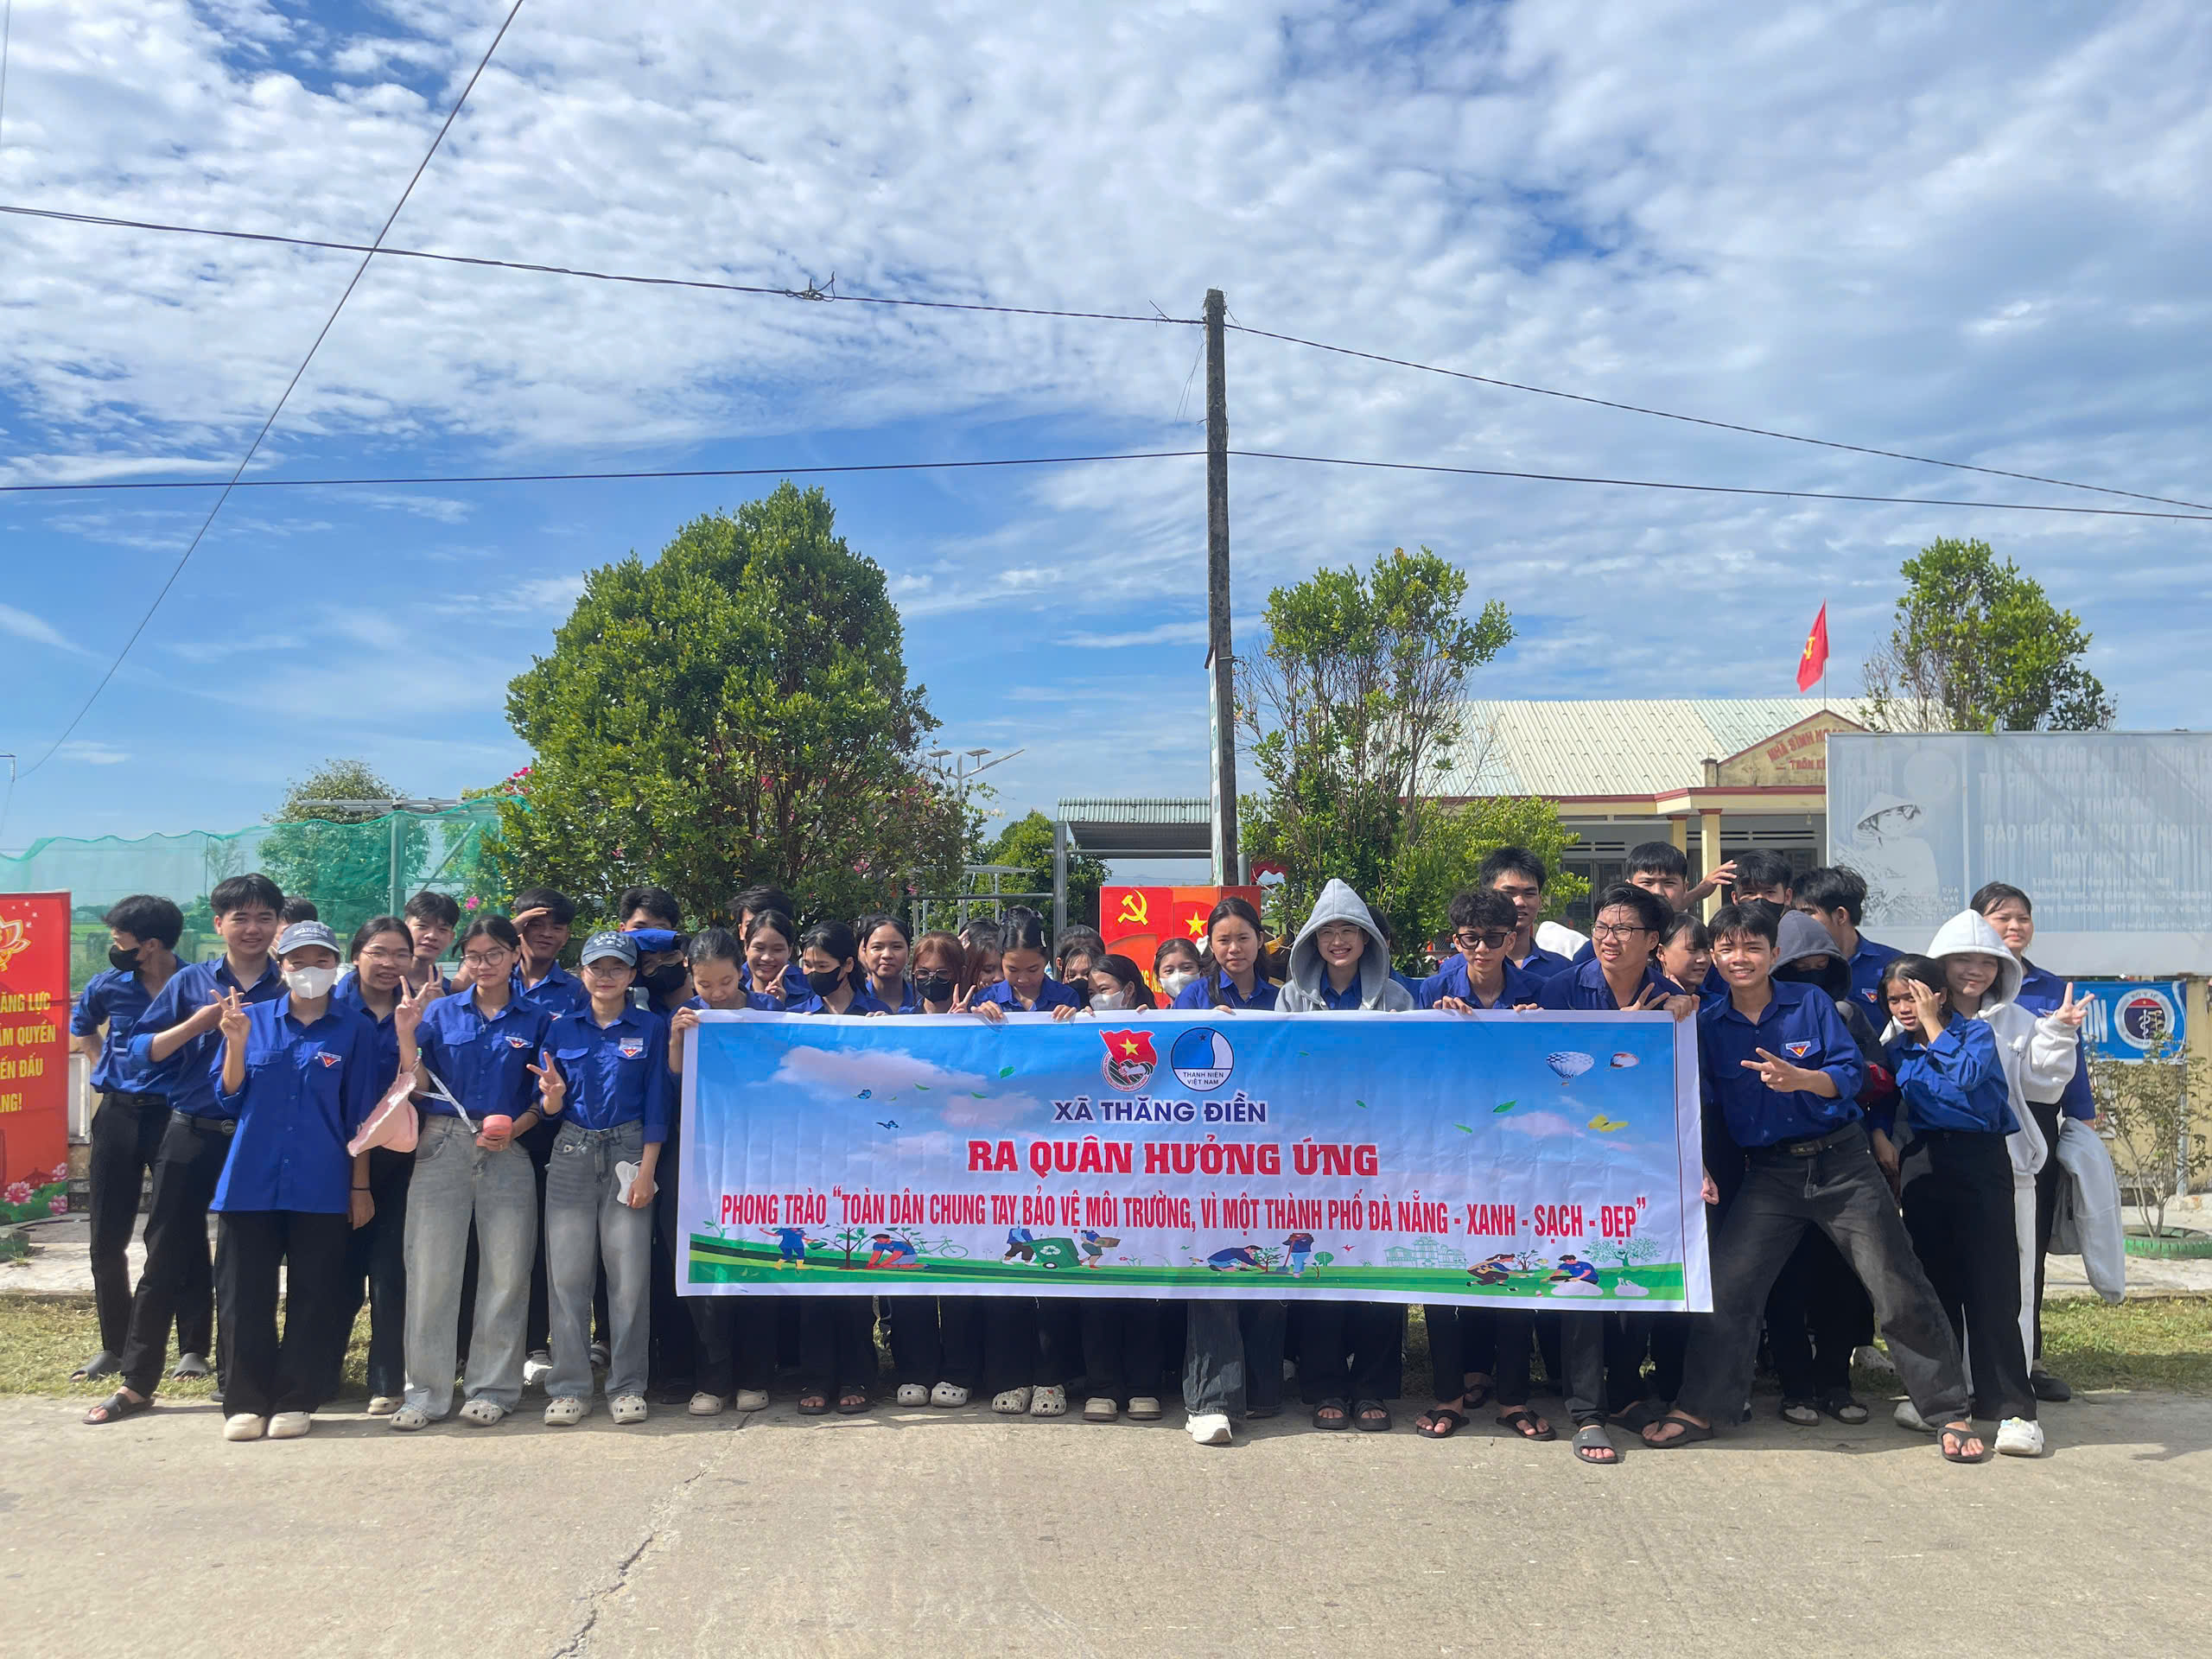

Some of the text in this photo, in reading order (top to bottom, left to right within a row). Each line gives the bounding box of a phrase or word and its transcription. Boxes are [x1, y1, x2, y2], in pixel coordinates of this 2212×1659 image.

[28, 991, 51, 1014] LỰC
[0, 1092, 22, 1113] NG!
[1054, 1092, 1266, 1122] XÃ THĂNG ĐIỀN
[968, 1134, 1377, 1179] RA QUÂN HƯỞNG ỨNG
[721, 1194, 779, 1225] PHONG
[785, 1188, 827, 1224] TRÀO
[890, 1188, 924, 1224] DÂN
[930, 1194, 985, 1225] CHUNG
[991, 1195, 1017, 1225] TAY
[1022, 1185, 1054, 1227] BẢO
[1060, 1190, 1080, 1234] VỆ
[1086, 1191, 1118, 1227] MÔI
[1123, 1190, 1196, 1232] TRƯỜNG,
[1201, 1192, 1217, 1229] VÌ
[1223, 1192, 1260, 1236] MỘT
[1264, 1192, 1322, 1230] THÀNH
[1328, 1189, 1363, 1230] PHỐ
[1368, 1194, 1393, 1231] ĐÀ
[1398, 1190, 1448, 1234] NẴNG
[1466, 1204, 1516, 1236] XANH
[1534, 1204, 1583, 1243] SẠCH
